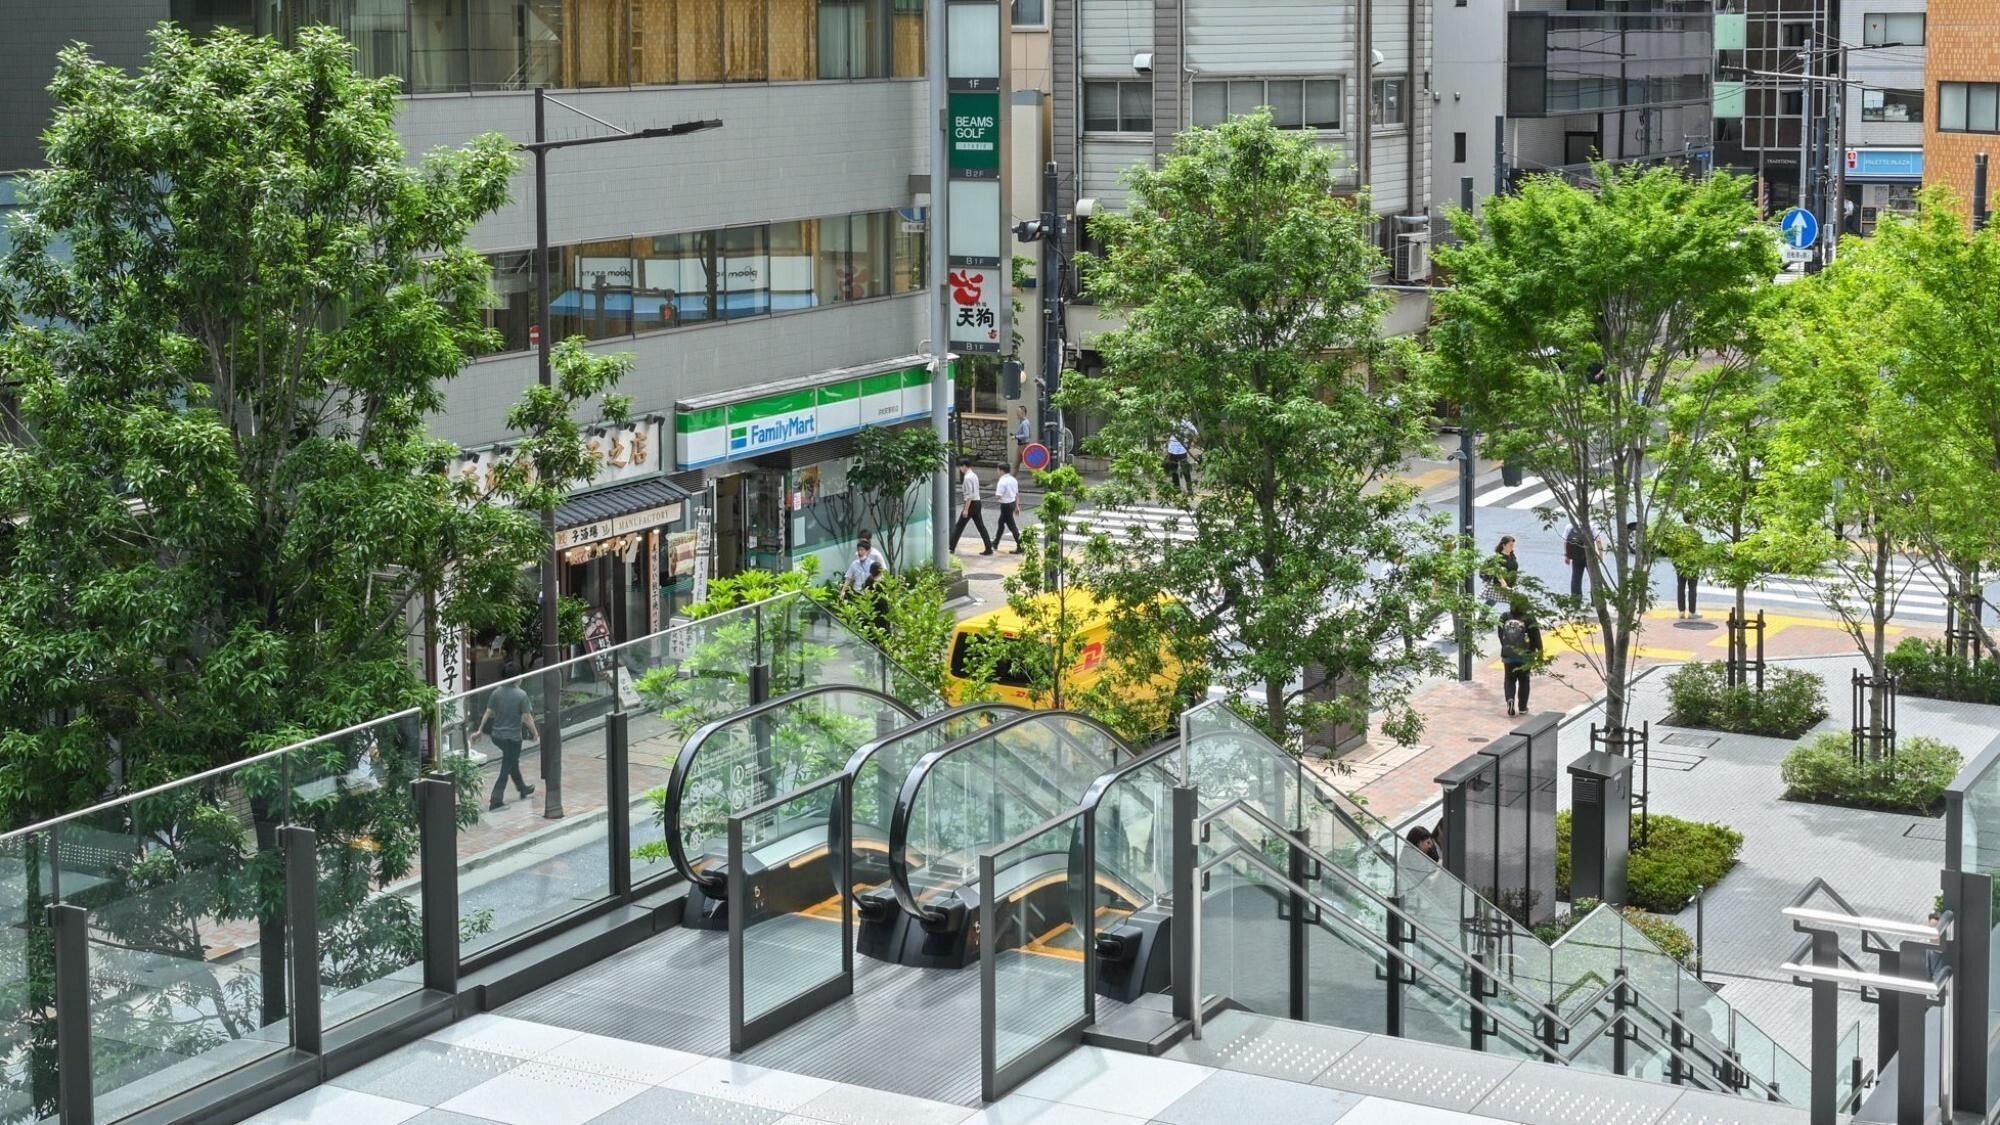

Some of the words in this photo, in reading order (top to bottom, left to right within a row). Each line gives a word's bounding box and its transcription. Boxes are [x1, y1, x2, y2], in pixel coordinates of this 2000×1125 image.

[968, 80, 980, 88] 1F
[955, 116, 994, 127] BEAMS
[955, 128, 985, 138] GOLF
[966, 257, 984, 265] B1F
[956, 307, 994, 328] 天狗
[966, 343, 984, 351] B1F
[751, 414, 815, 445] FamilyMart
